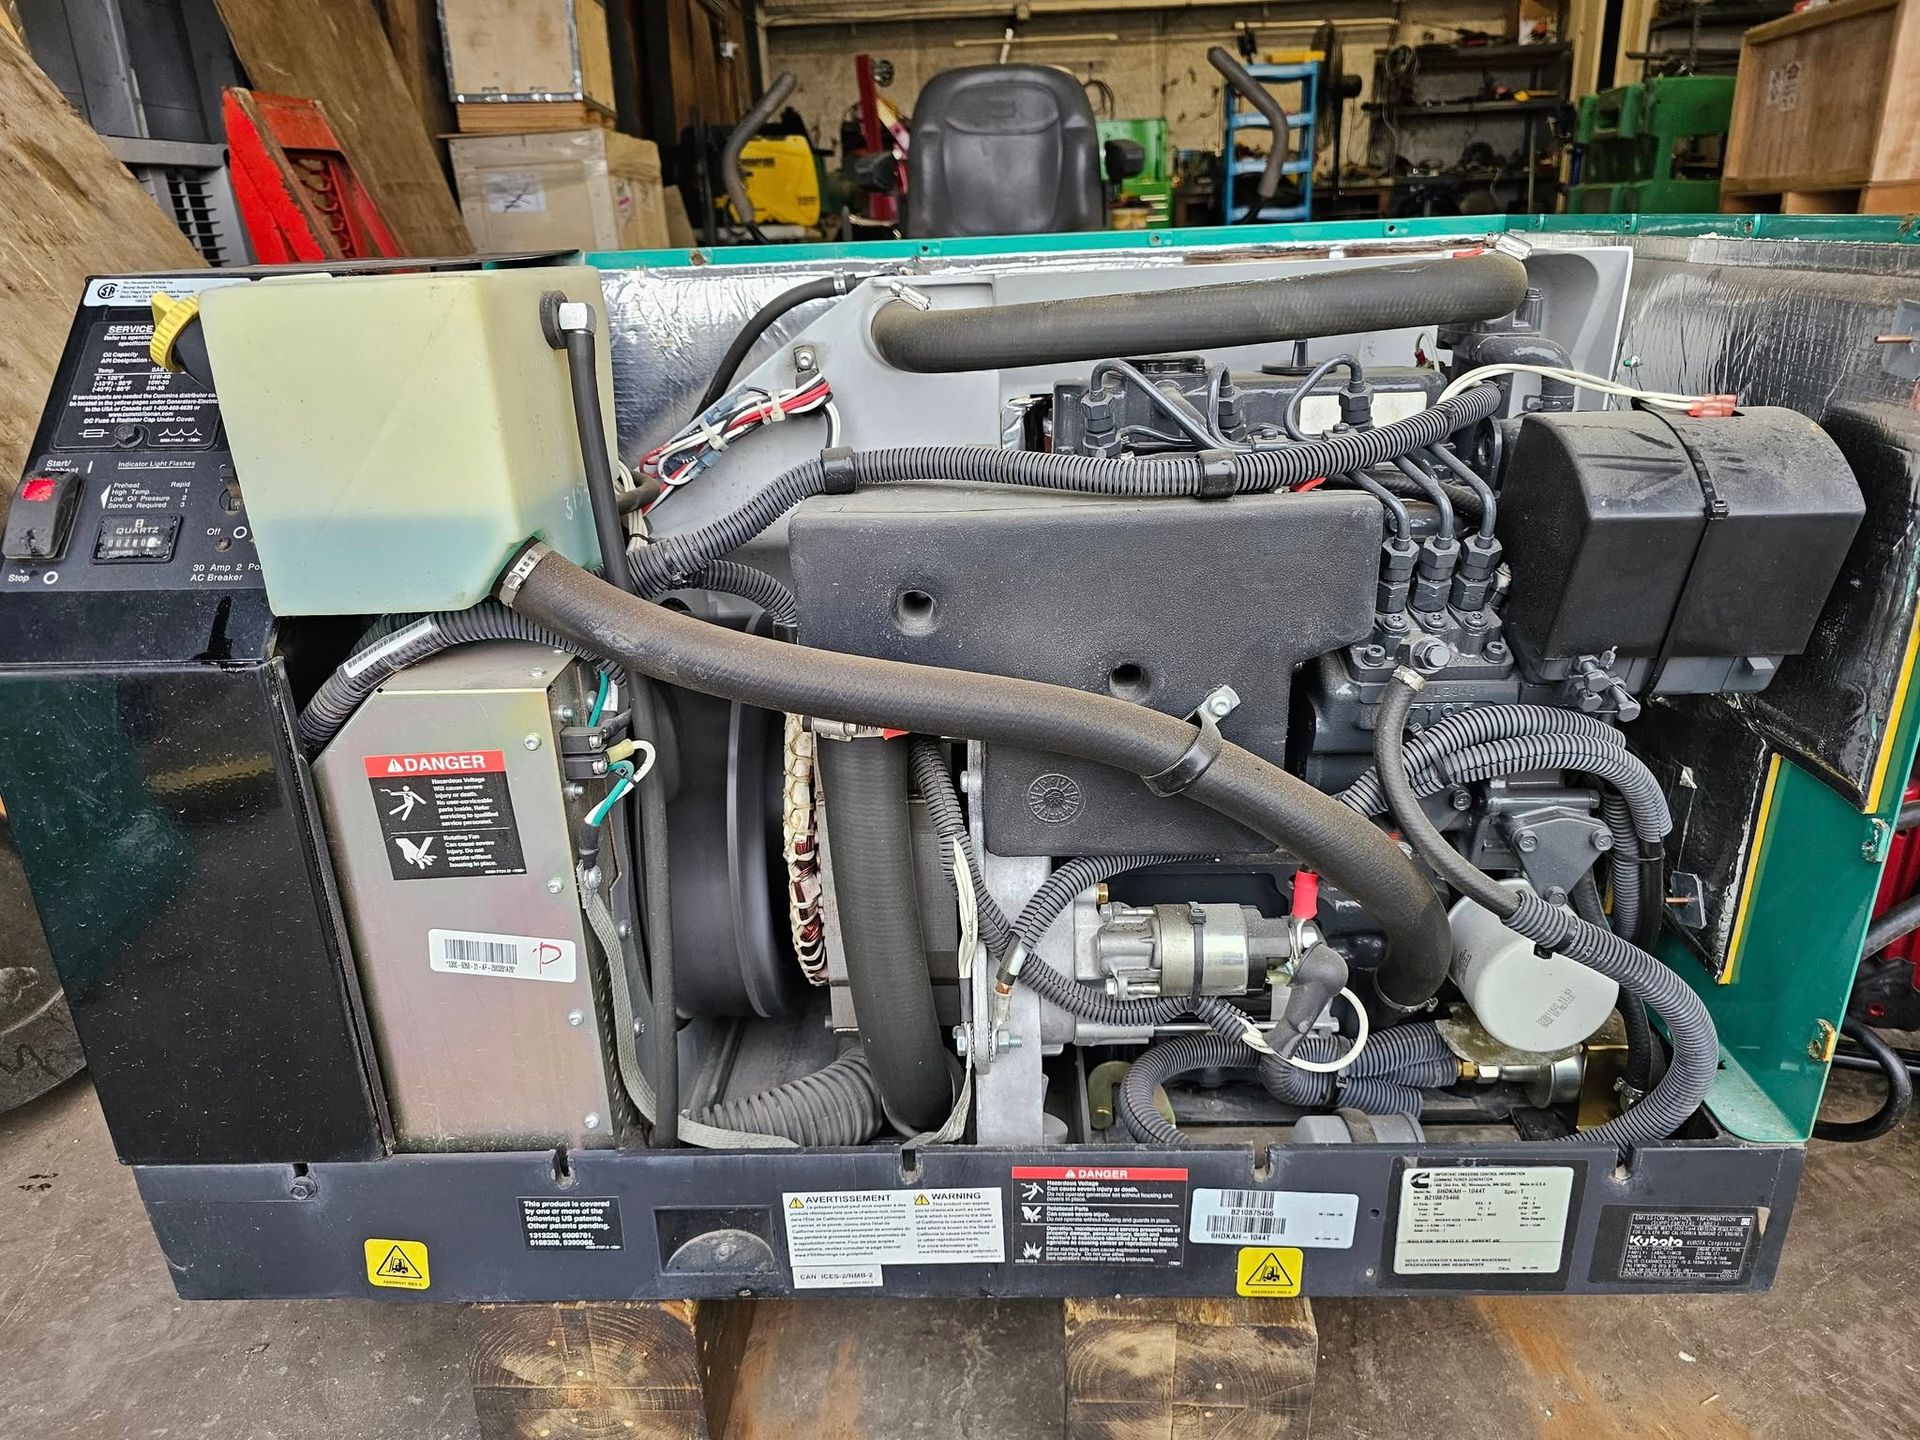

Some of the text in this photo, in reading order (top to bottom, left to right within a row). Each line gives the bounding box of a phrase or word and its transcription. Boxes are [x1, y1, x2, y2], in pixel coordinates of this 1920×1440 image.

[108, 325, 154, 334] SERVICE
[46, 459, 72, 467] Start/
[206, 528, 221, 536] Off
[193, 564, 205, 572] 30
[210, 564, 231, 573] Amp
[8, 574, 30, 583] Stop
[207, 573, 243, 581] Breaker
[404, 755, 486, 772] DANGER
[474, 811, 499, 819] qualified
[1078, 1169, 1128, 1179] DANGER
[805, 1192, 981, 1203] AVERTISSEMENT WARNING
[523, 1200, 540, 1208] This
[541, 1200, 570, 1208] product
[1250, 1233, 1271, 1241] 1044T
[1629, 1235, 1683, 1246] Kubota
